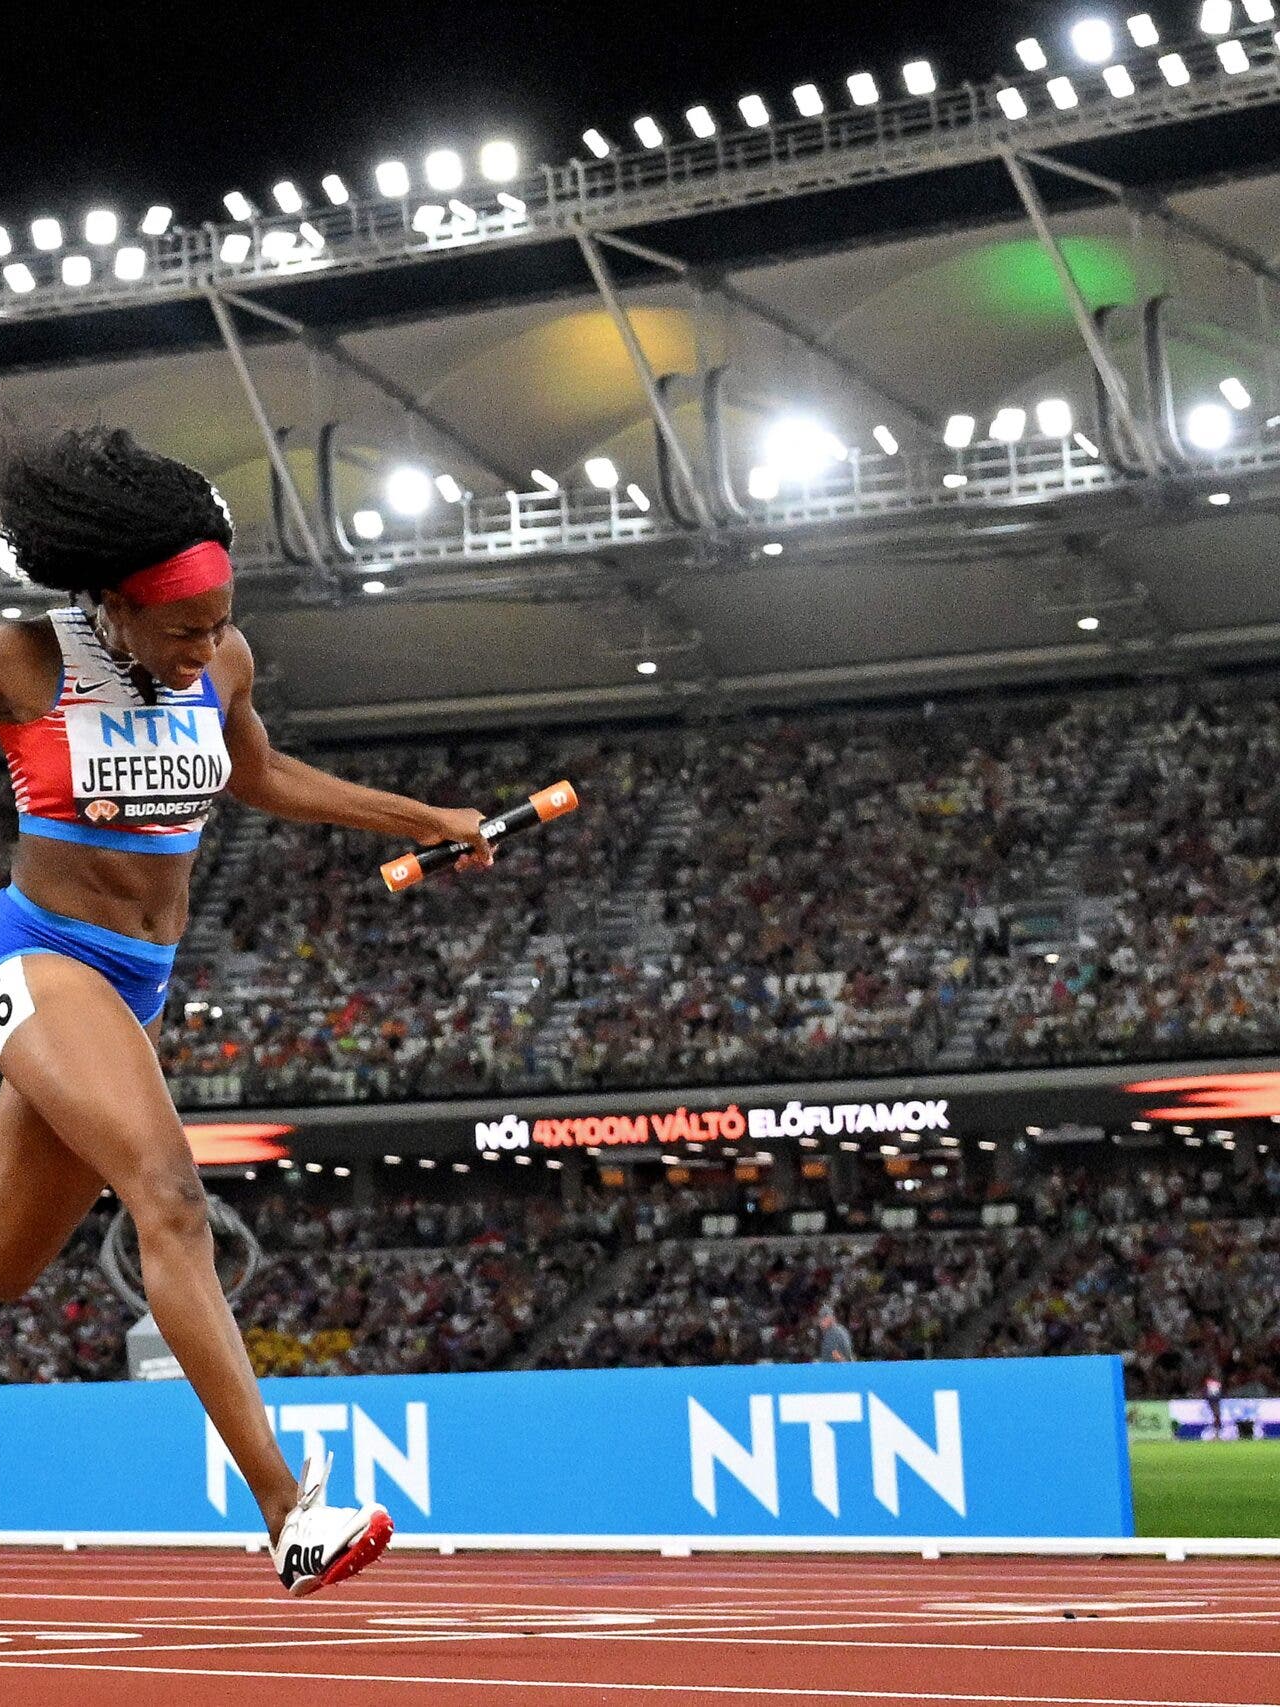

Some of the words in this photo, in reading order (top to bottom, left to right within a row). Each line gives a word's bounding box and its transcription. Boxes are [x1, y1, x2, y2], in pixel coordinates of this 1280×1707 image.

[99, 709, 199, 747] NTN
[82, 754, 223, 792] JEFFERSON
[531, 1115, 649, 1147] 4X100M
[686, 1389, 967, 1519] NTN
